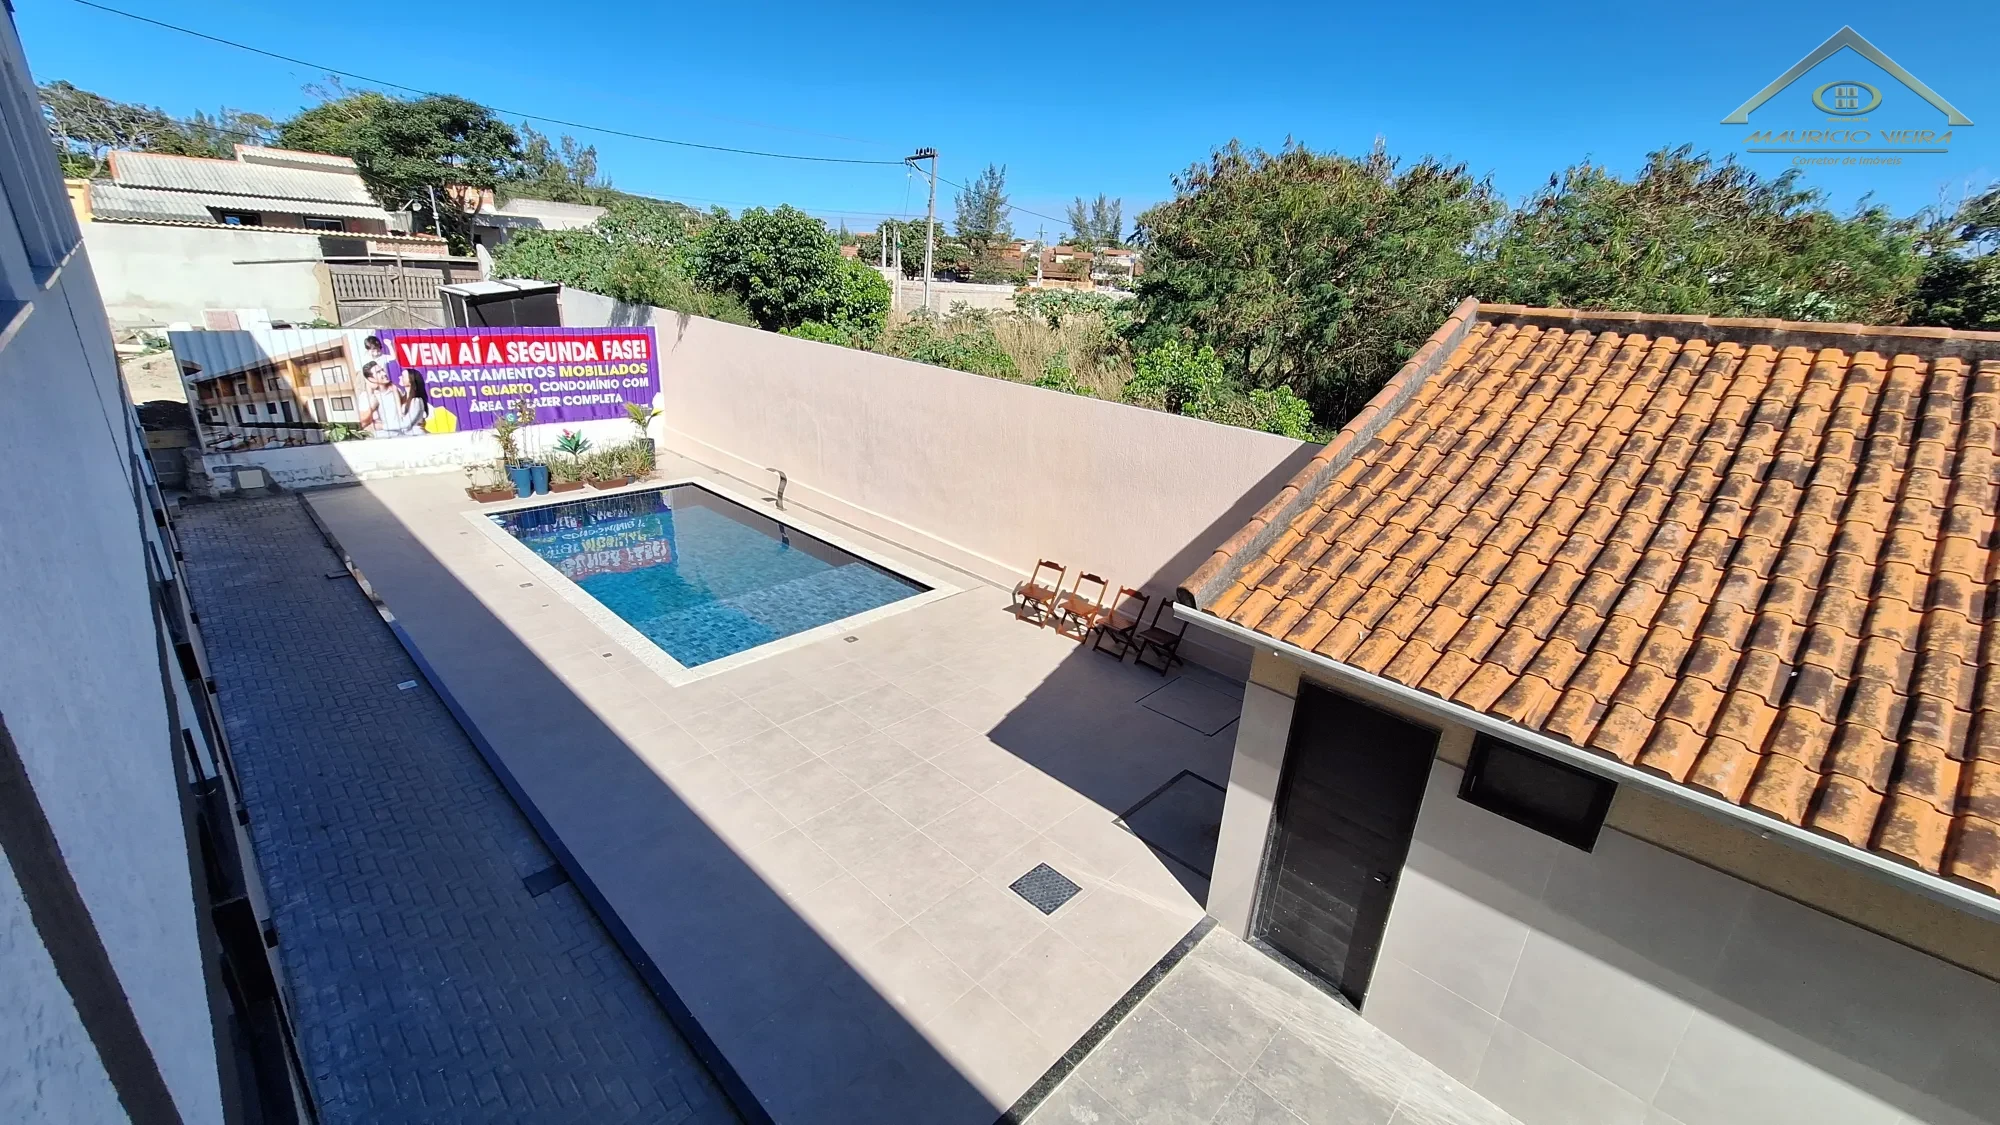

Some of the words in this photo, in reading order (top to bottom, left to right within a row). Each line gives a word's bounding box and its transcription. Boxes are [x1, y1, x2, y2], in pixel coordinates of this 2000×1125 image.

[401, 342, 452, 366] VEM
[458, 335, 482, 365] AÍ
[486, 342, 503, 362] A
[506, 341, 599, 363] SEGUNDA
[602, 339, 647, 361] FASE!
[425, 366, 556, 383] APARTAMENTOS
[559, 363, 648, 378] MOBILIADOS
[430, 386, 466, 399] COM
[470, 386, 477, 397] 1
[481, 383, 538, 396] QUARTO,
[540, 378, 620, 393] CONDOMÍNIO
[622, 377, 649, 389] COM
[470, 399, 504, 412] ÁREA
[526, 396, 561, 408] LAZER
[562, 393, 624, 407] COMPLETA
